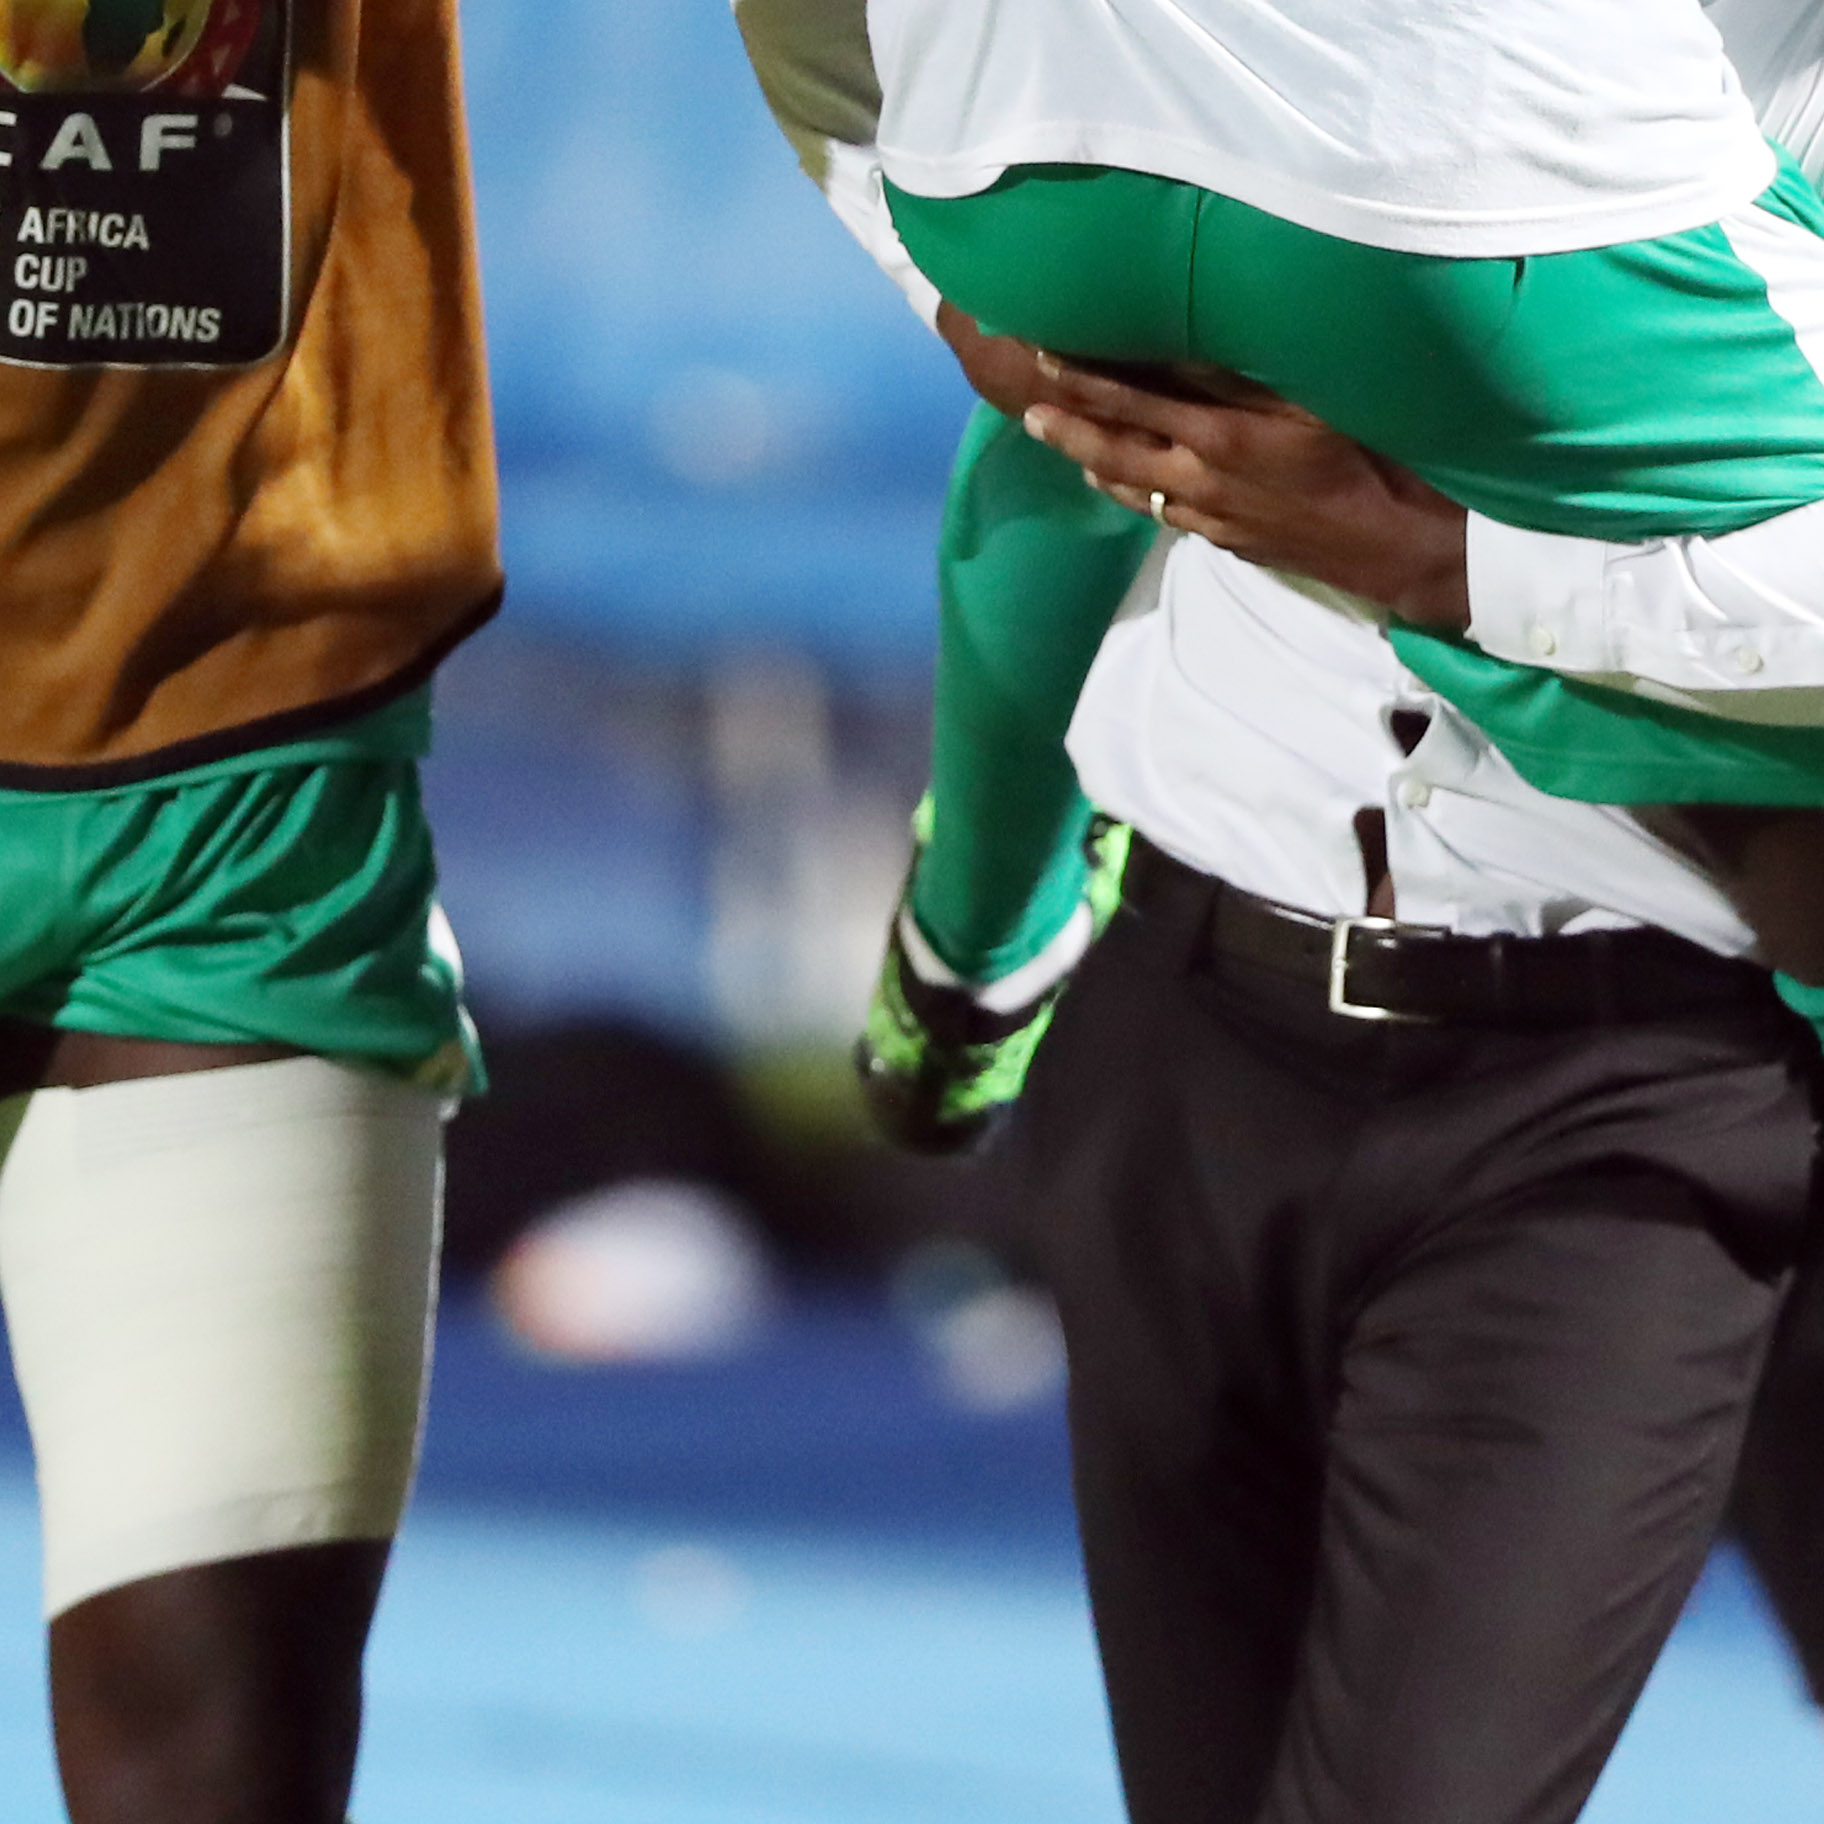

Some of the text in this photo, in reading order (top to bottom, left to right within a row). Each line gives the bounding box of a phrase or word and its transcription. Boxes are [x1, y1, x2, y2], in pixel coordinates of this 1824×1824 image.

[16, 206, 151, 251] AFRICA
[13, 253, 89, 293] CUP
[8, 298, 222, 343] OF NATIONS
